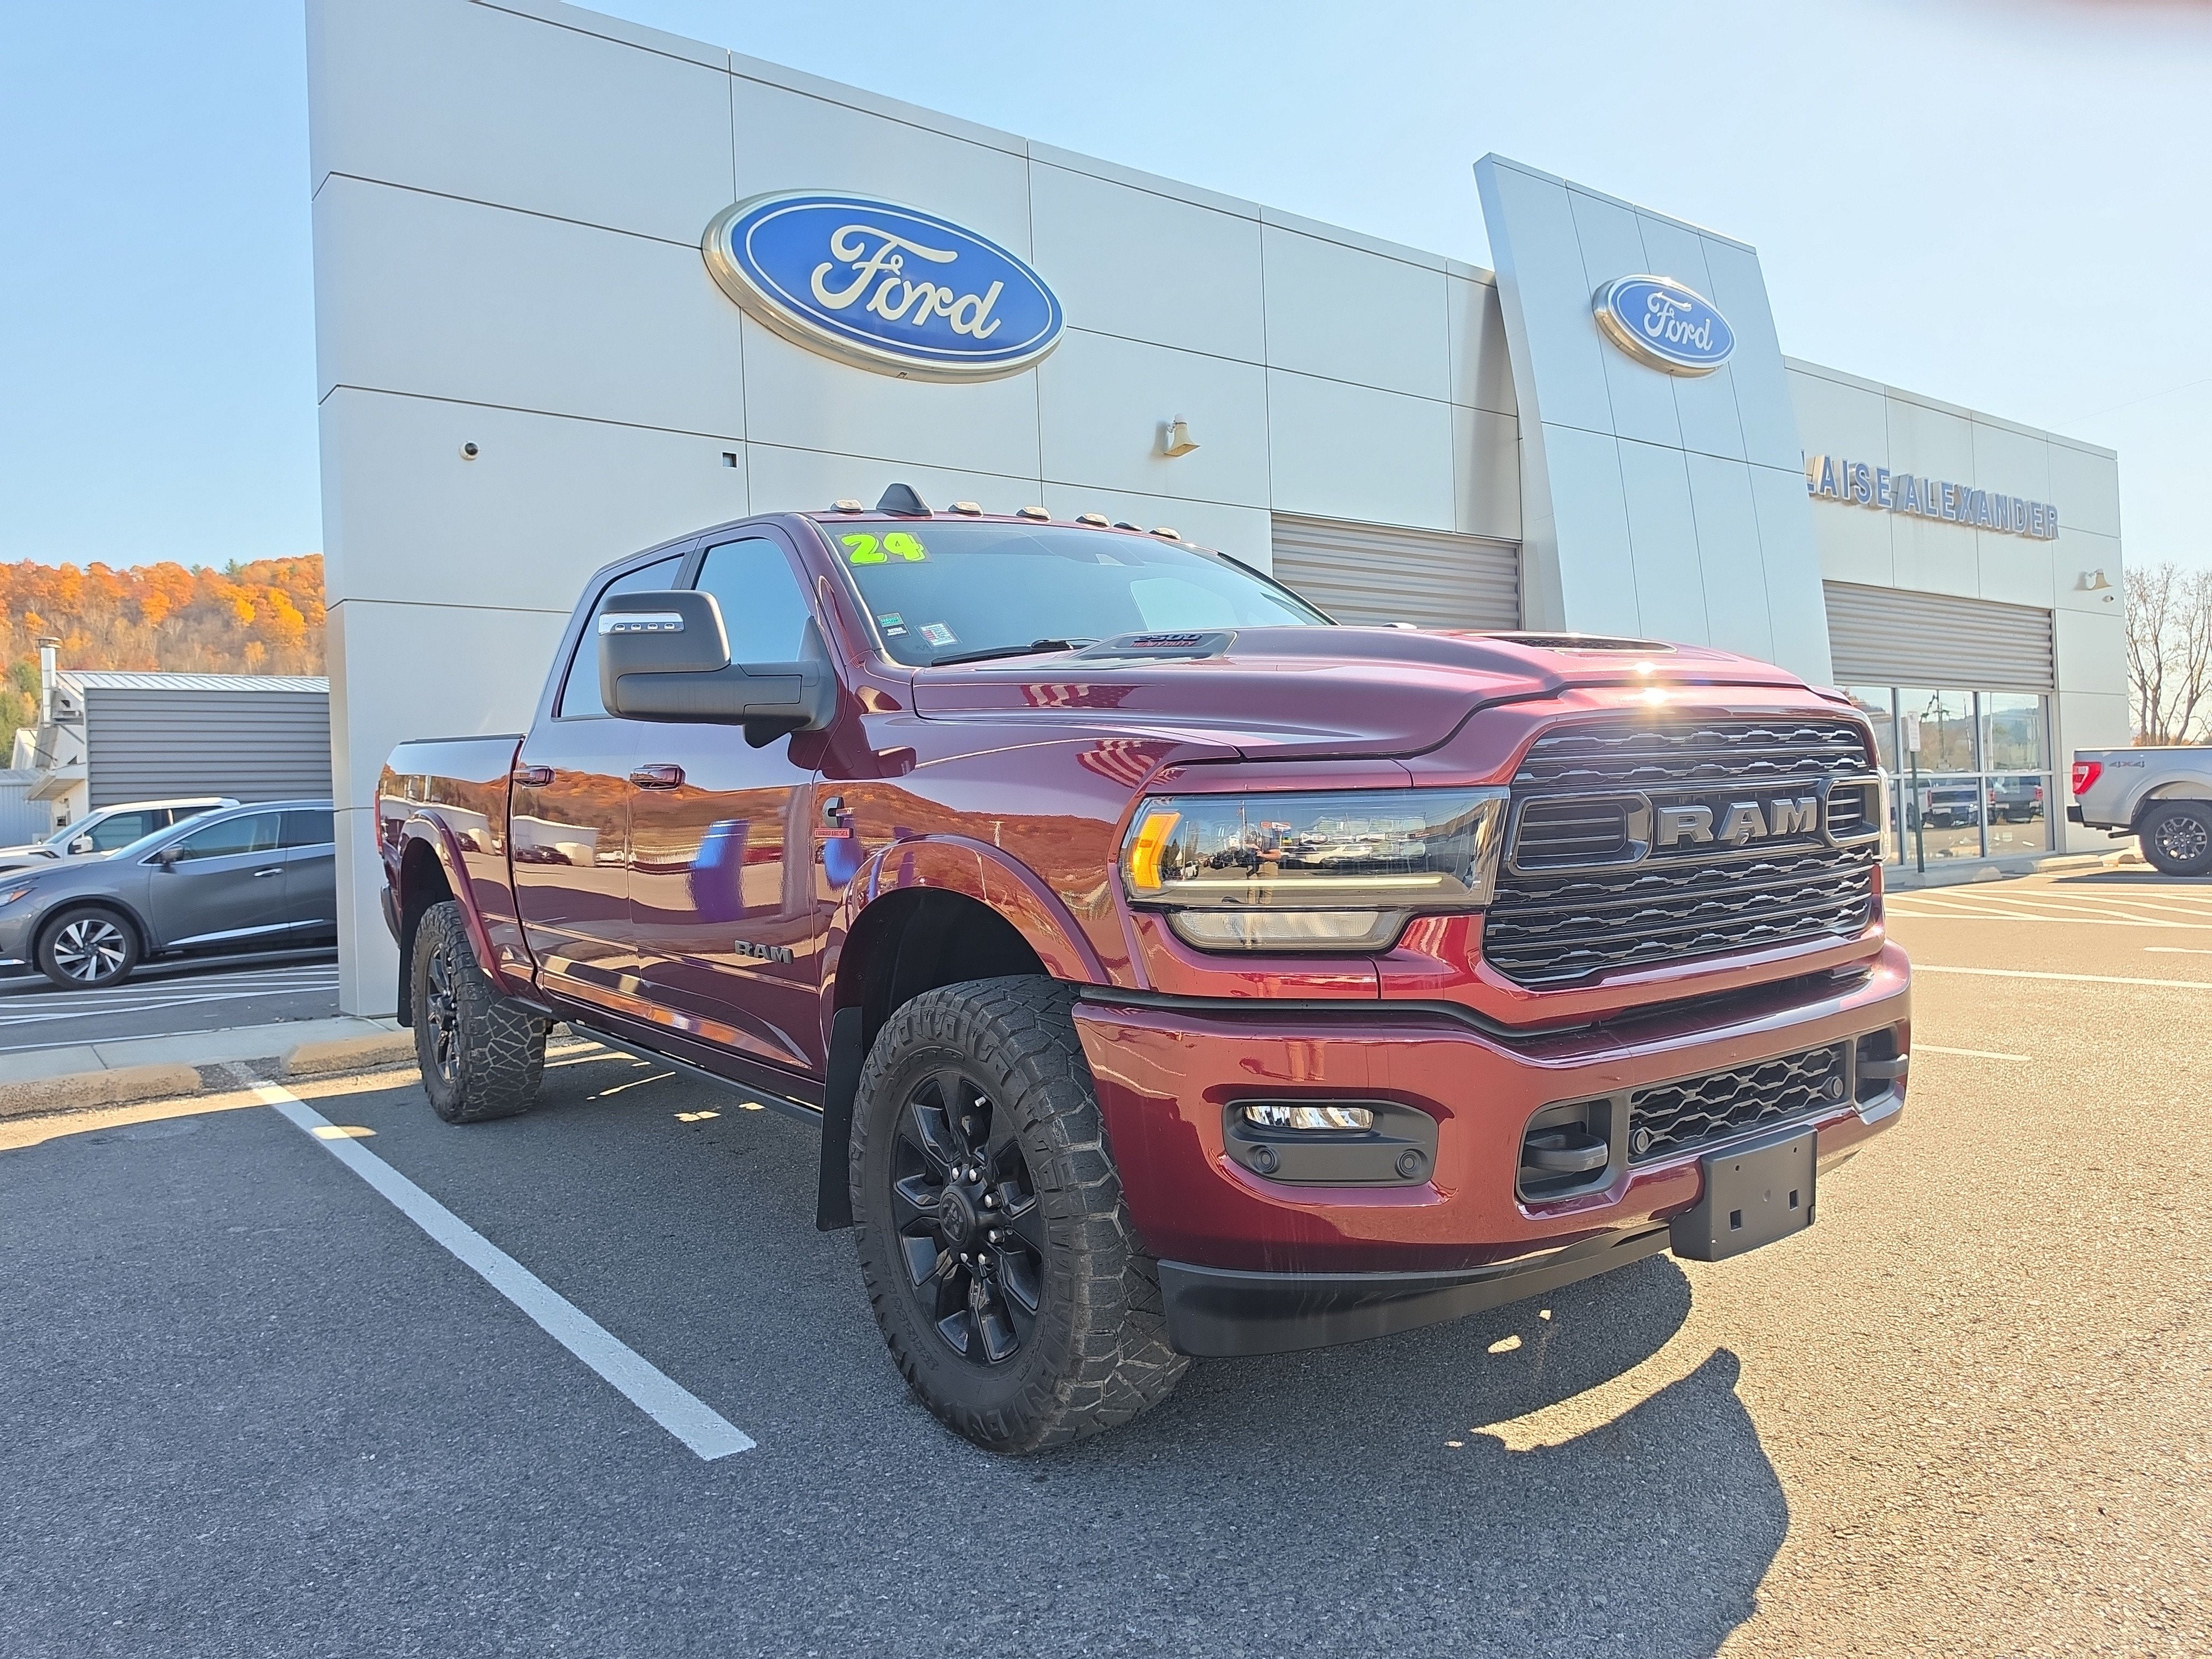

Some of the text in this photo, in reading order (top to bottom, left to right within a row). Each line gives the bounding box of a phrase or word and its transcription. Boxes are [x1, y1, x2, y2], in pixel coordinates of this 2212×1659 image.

[811, 224, 1004, 339] Ford
[1643, 291, 1713, 351] Ford
[1903, 473, 2059, 540] ALEXANDER
[841, 532, 925, 564] 24
[1657, 796, 1817, 845] RAM
[735, 940, 794, 964] RAM
